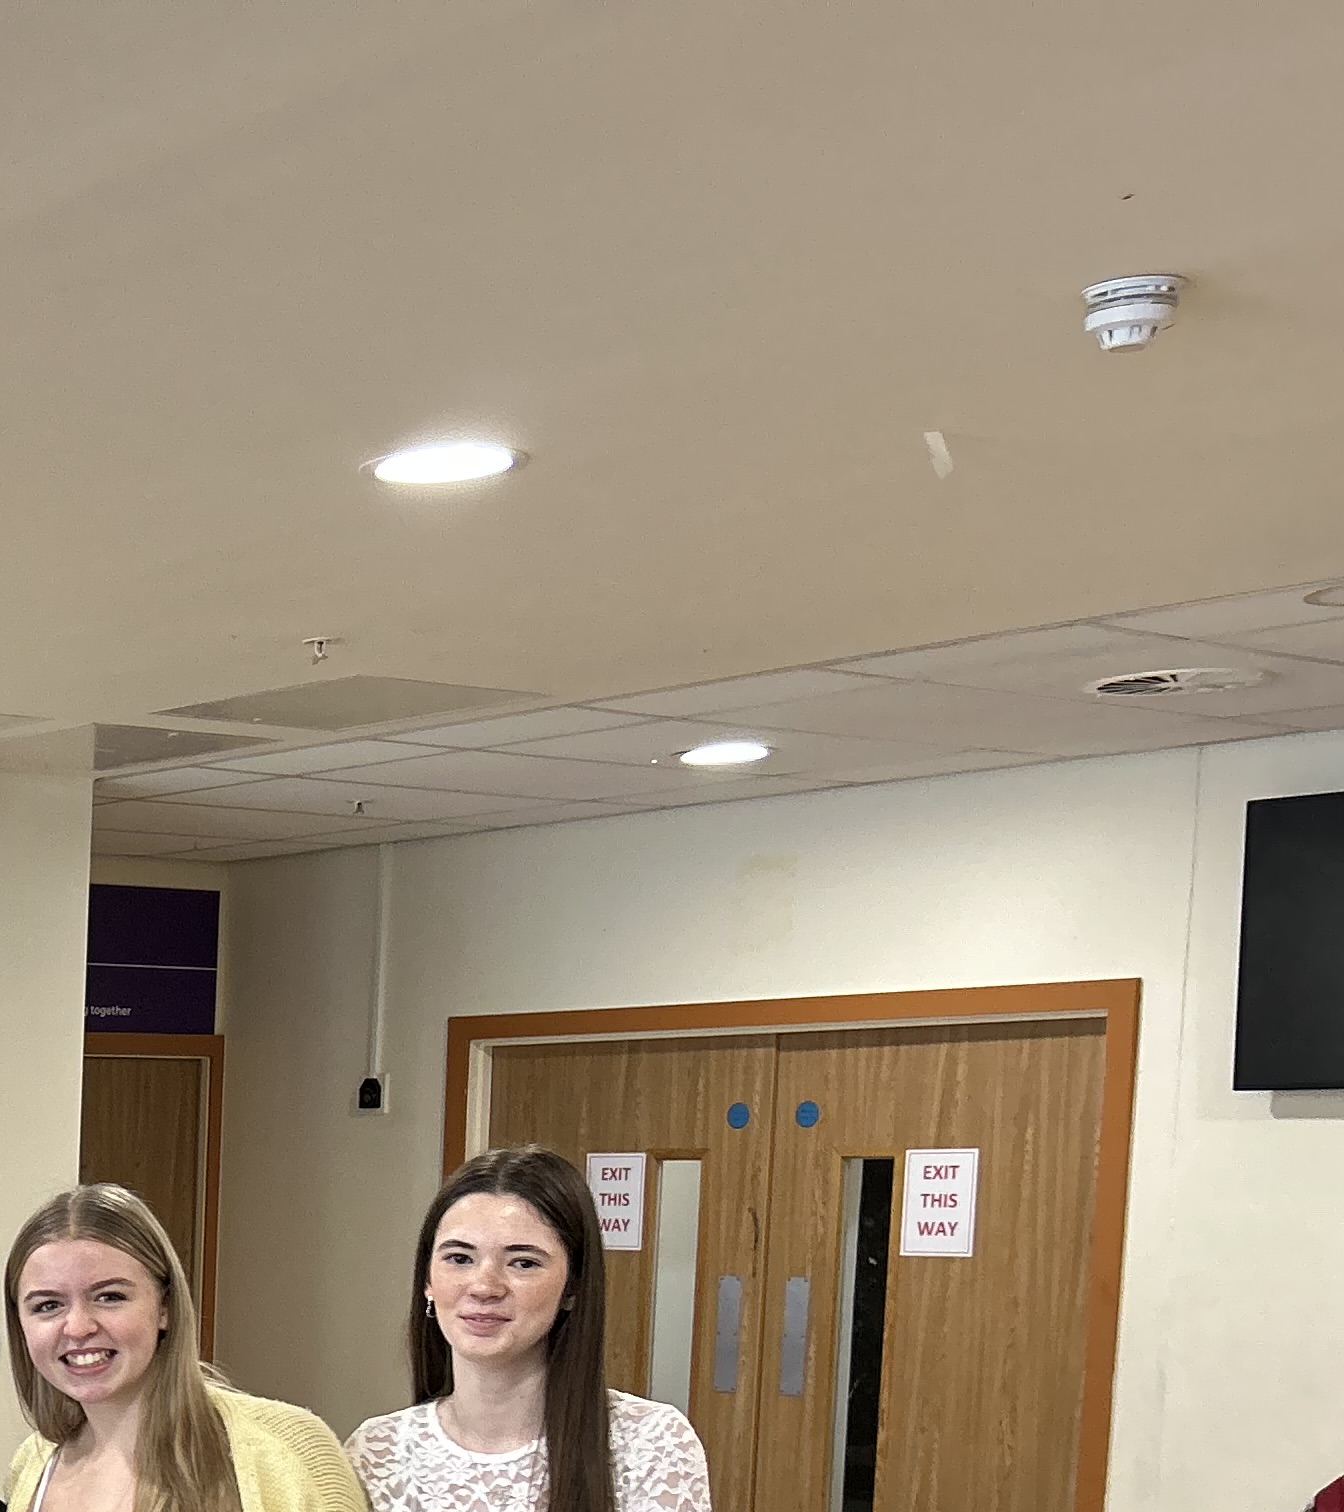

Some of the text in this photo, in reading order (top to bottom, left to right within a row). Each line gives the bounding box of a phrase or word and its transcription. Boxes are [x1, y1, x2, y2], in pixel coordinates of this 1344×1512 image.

[90, 1005, 132, 1018] together
[601, 1167, 632, 1181] EXIT
[923, 1165, 960, 1180] EXIT
[598, 1193, 630, 1206] THIS
[920, 1193, 958, 1208] THIS
[600, 1218, 631, 1232] WAY
[917, 1221, 959, 1236] WAY
